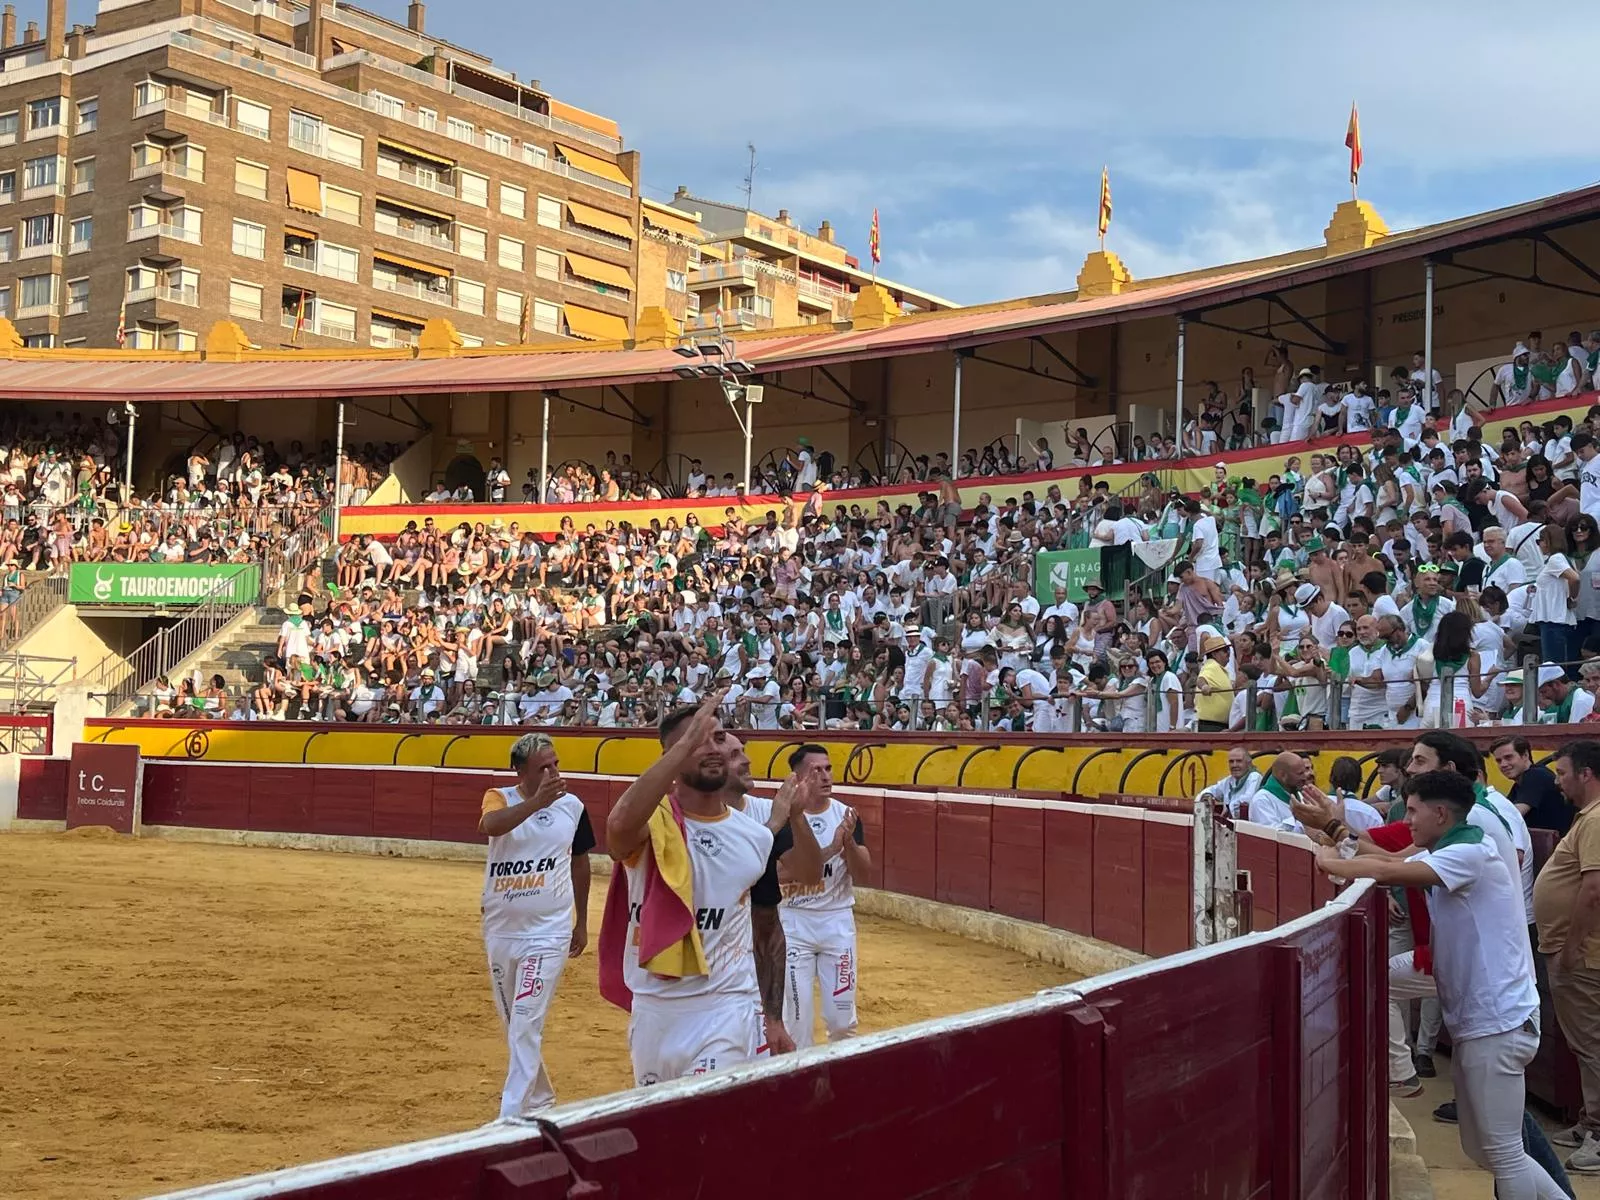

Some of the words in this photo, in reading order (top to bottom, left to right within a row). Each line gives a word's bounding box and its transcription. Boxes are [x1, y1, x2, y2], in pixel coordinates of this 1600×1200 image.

[1073, 562, 1101, 573] ARAG
[1074, 577, 1087, 587] TV
[490, 860, 534, 877] TOROS
[537, 857, 557, 872] EN
[503, 888, 541, 902] Agencia
[695, 907, 725, 930] EN
